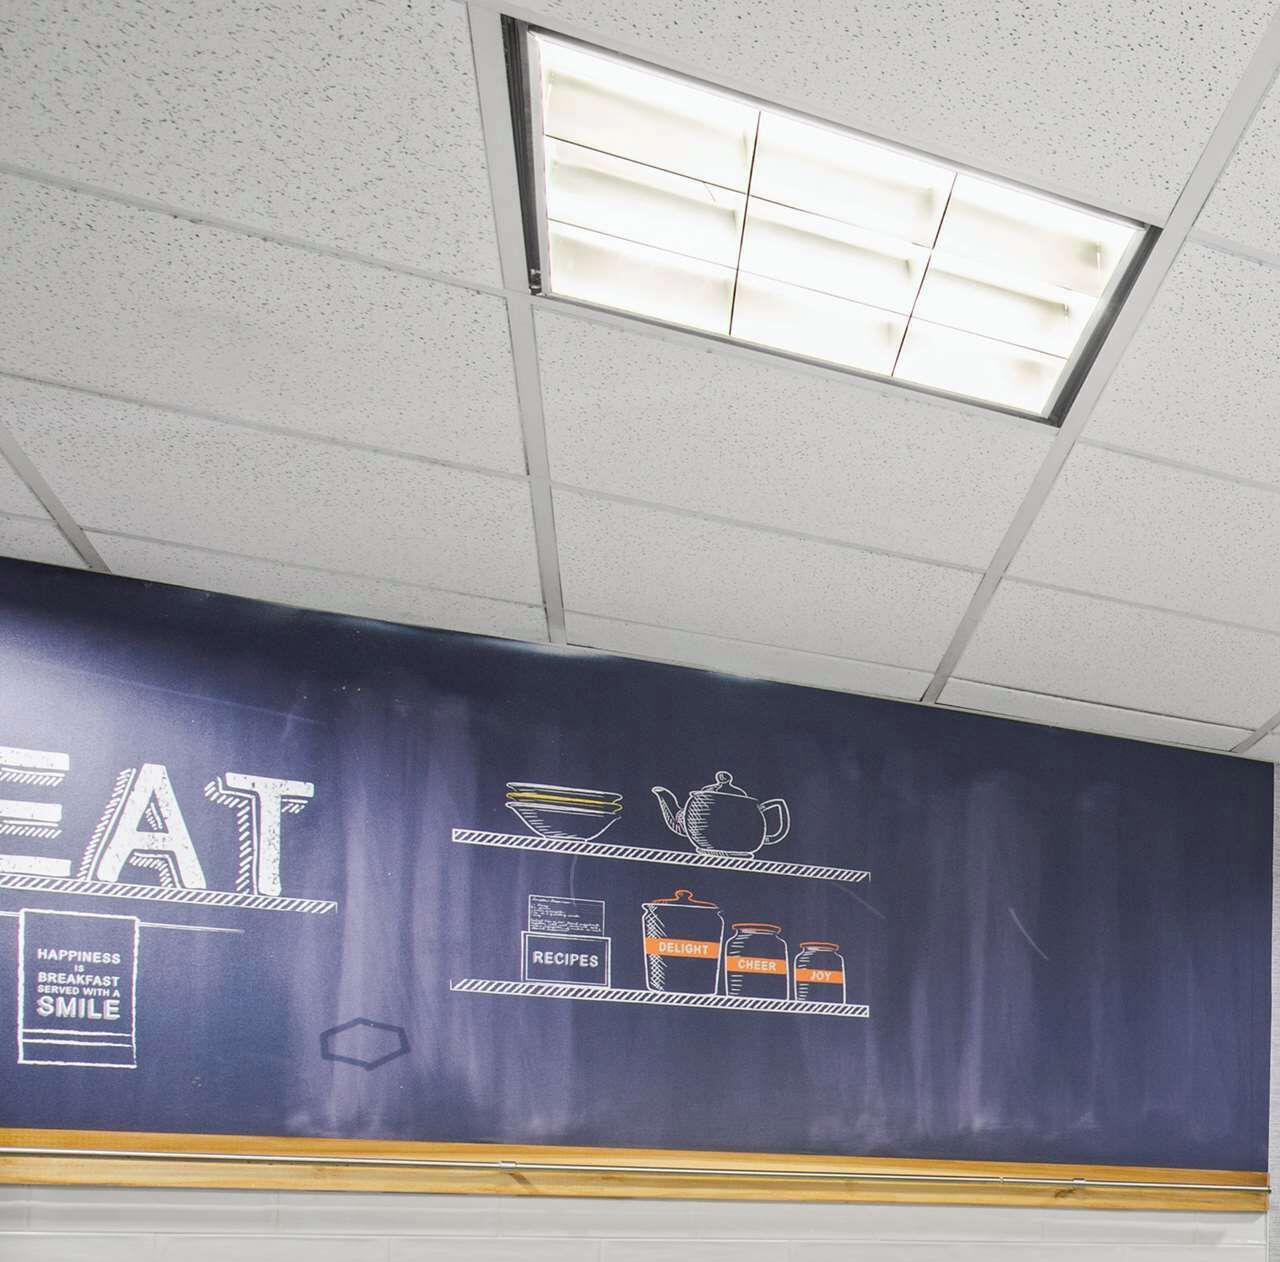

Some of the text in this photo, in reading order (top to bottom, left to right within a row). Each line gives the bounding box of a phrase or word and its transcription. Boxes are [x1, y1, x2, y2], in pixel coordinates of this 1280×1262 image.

[658, 942, 710, 955] DELIGHT
[37, 948, 121, 964] HAPPINESS
[532, 949, 599, 969] RECIPES
[74, 964, 85, 972] IS
[737, 959, 777, 971] CHEER
[38, 971, 120, 987] BREAKFAST
[809, 969, 832, 981] JOY
[37, 984, 120, 998] SERVED WITH A
[36, 995, 121, 1020] SMILE
